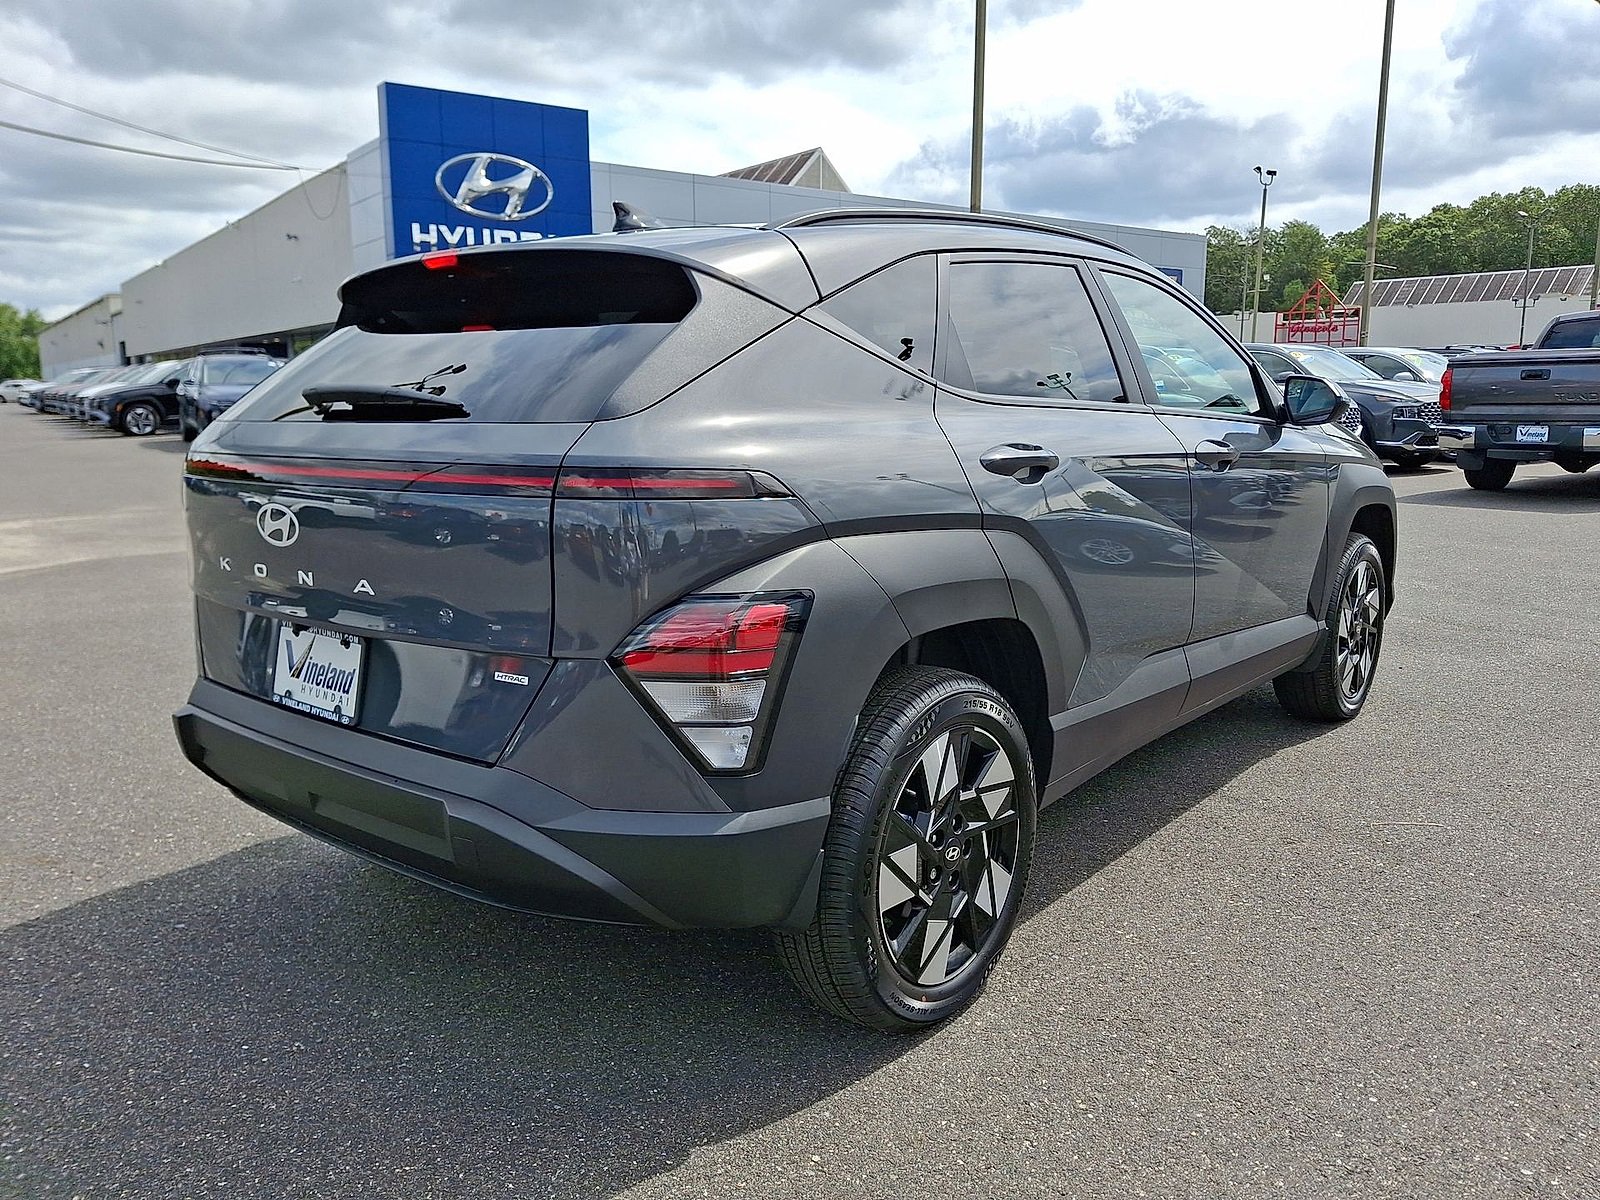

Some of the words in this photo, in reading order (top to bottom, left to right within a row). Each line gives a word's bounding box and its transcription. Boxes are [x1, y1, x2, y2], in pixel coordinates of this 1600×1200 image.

[1553, 392, 1600, 402] TUND
[219, 555, 376, 597] KONA
[285, 633, 357, 696] Vineland
[496, 673, 527, 684] HTRAC
[300, 683, 350, 707] HYUNDAI
[963, 699, 988, 710] 215/55
[281, 696, 311, 713] VINELAND
[310, 706, 339, 721] HYUNDAI
[889, 991, 930, 1016] ALL-SEASON
